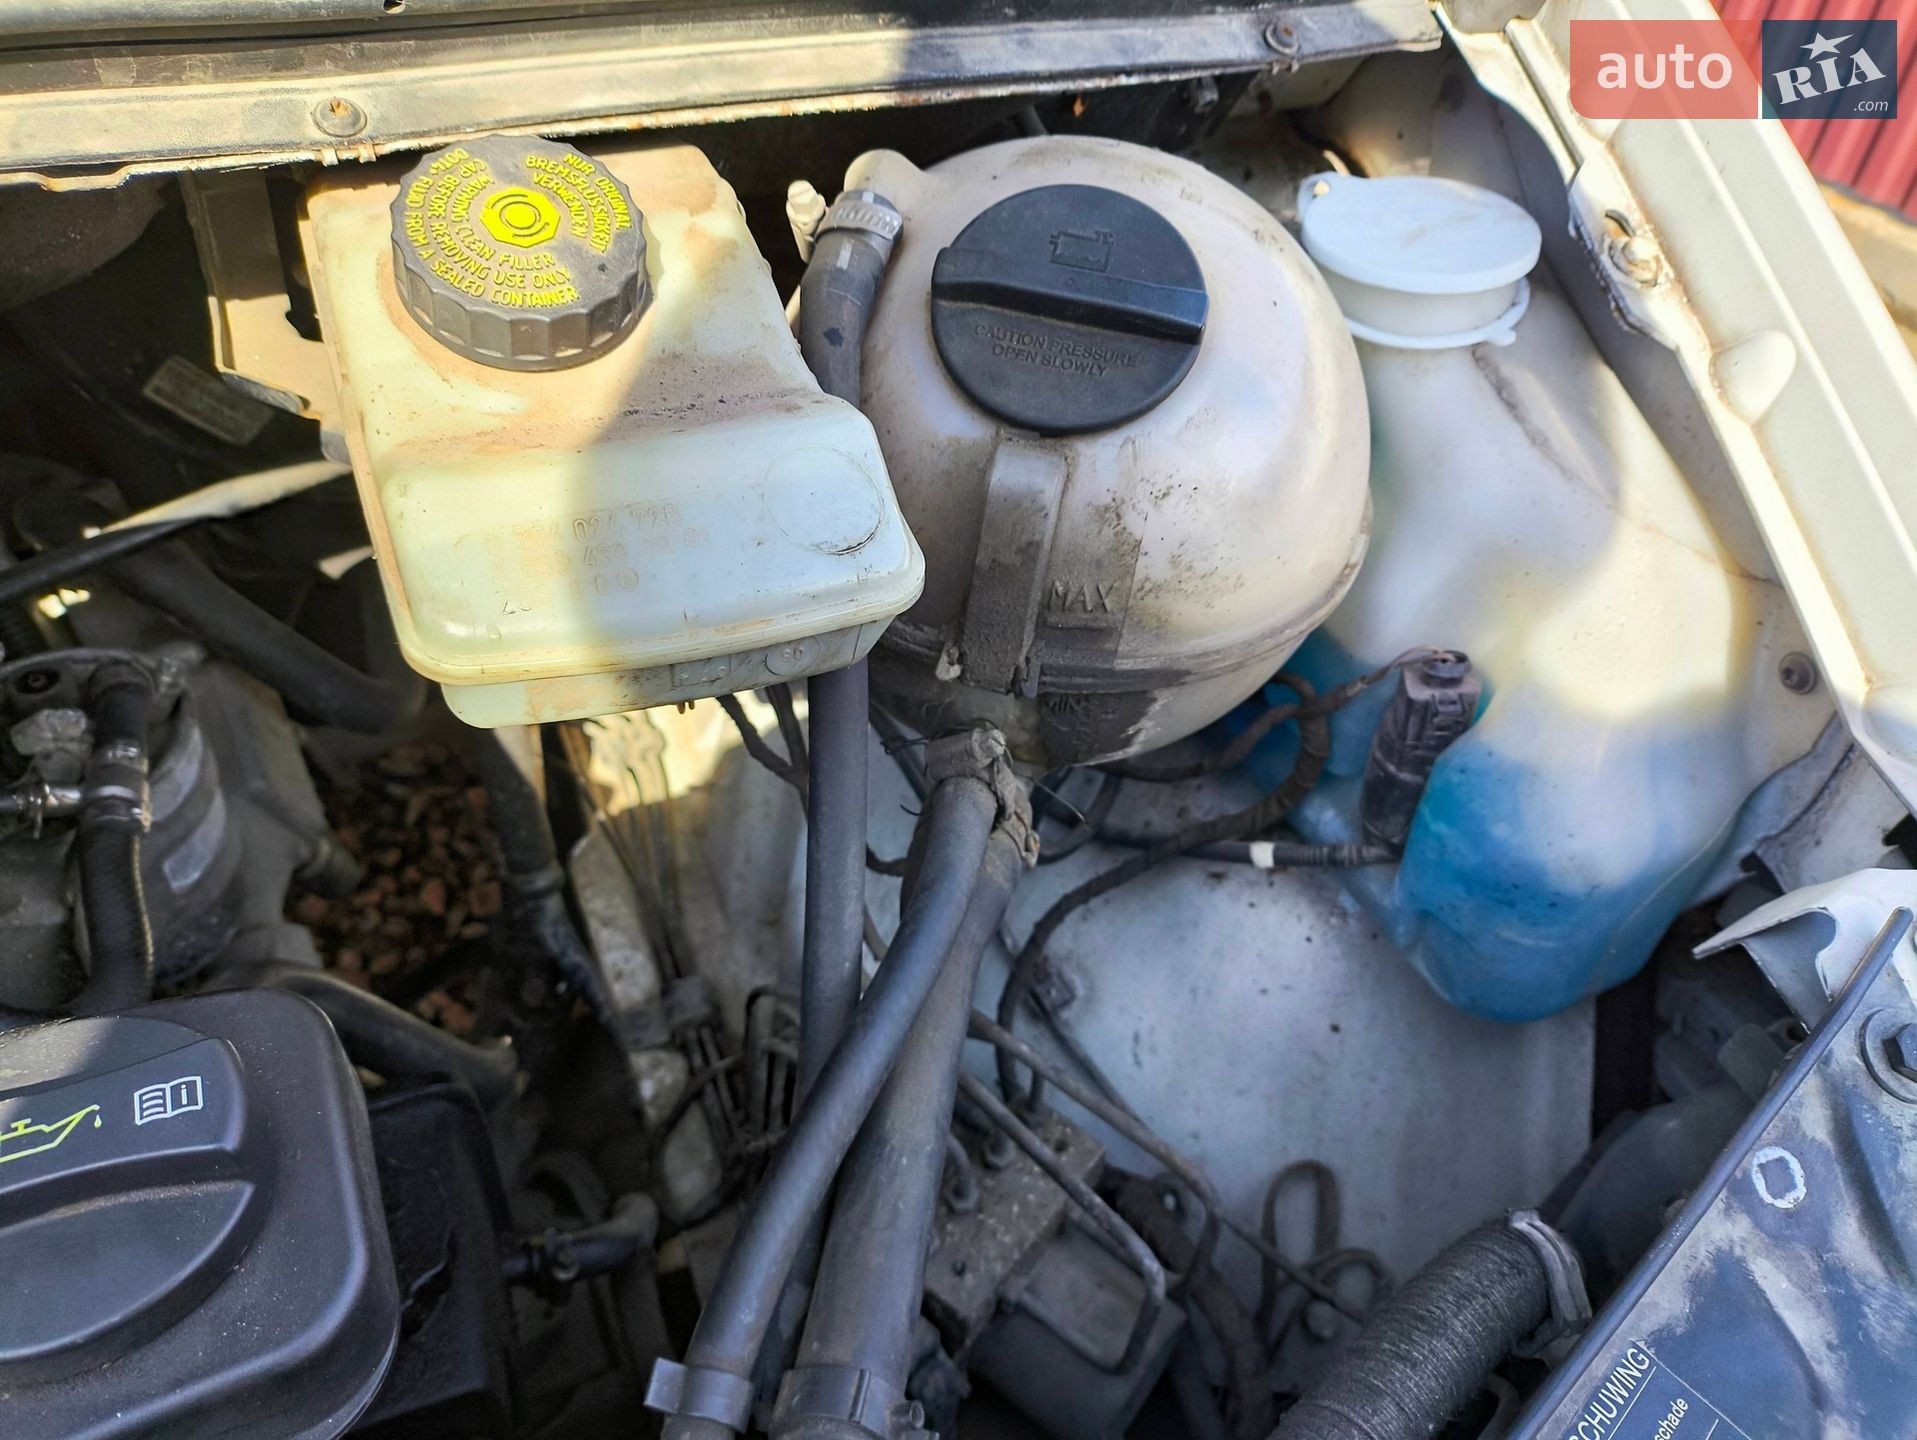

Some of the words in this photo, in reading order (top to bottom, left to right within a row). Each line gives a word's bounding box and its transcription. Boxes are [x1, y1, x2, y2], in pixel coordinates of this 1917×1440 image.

[460, 159, 486, 178] CAP
[406, 176, 434, 208] FLUID
[428, 175, 461, 219] BEFORE
[452, 174, 495, 222] WARNING
[533, 172, 588, 238] VERWENDEN
[563, 153, 596, 176] NUR
[595, 176, 632, 230] ORIGINAL
[405, 211, 430, 248] FROM
[456, 225, 496, 261] CLEAN
[418, 248, 436, 261] A
[430, 222, 491, 280] REMOVING
[499, 253, 555, 271] FILLER
[430, 258, 486, 297] SEALED
[493, 270, 526, 288] USE
[532, 265, 571, 288] ONLY
[491, 286, 579, 308] CONTAINER
[975, 324, 1048, 351] CAUTION
[1051, 341, 1136, 368] PRESSURE
[992, 344, 1037, 364] OPEN
[1042, 355, 1108, 377] SLOWLY
[1050, 579, 1117, 613] MAX
